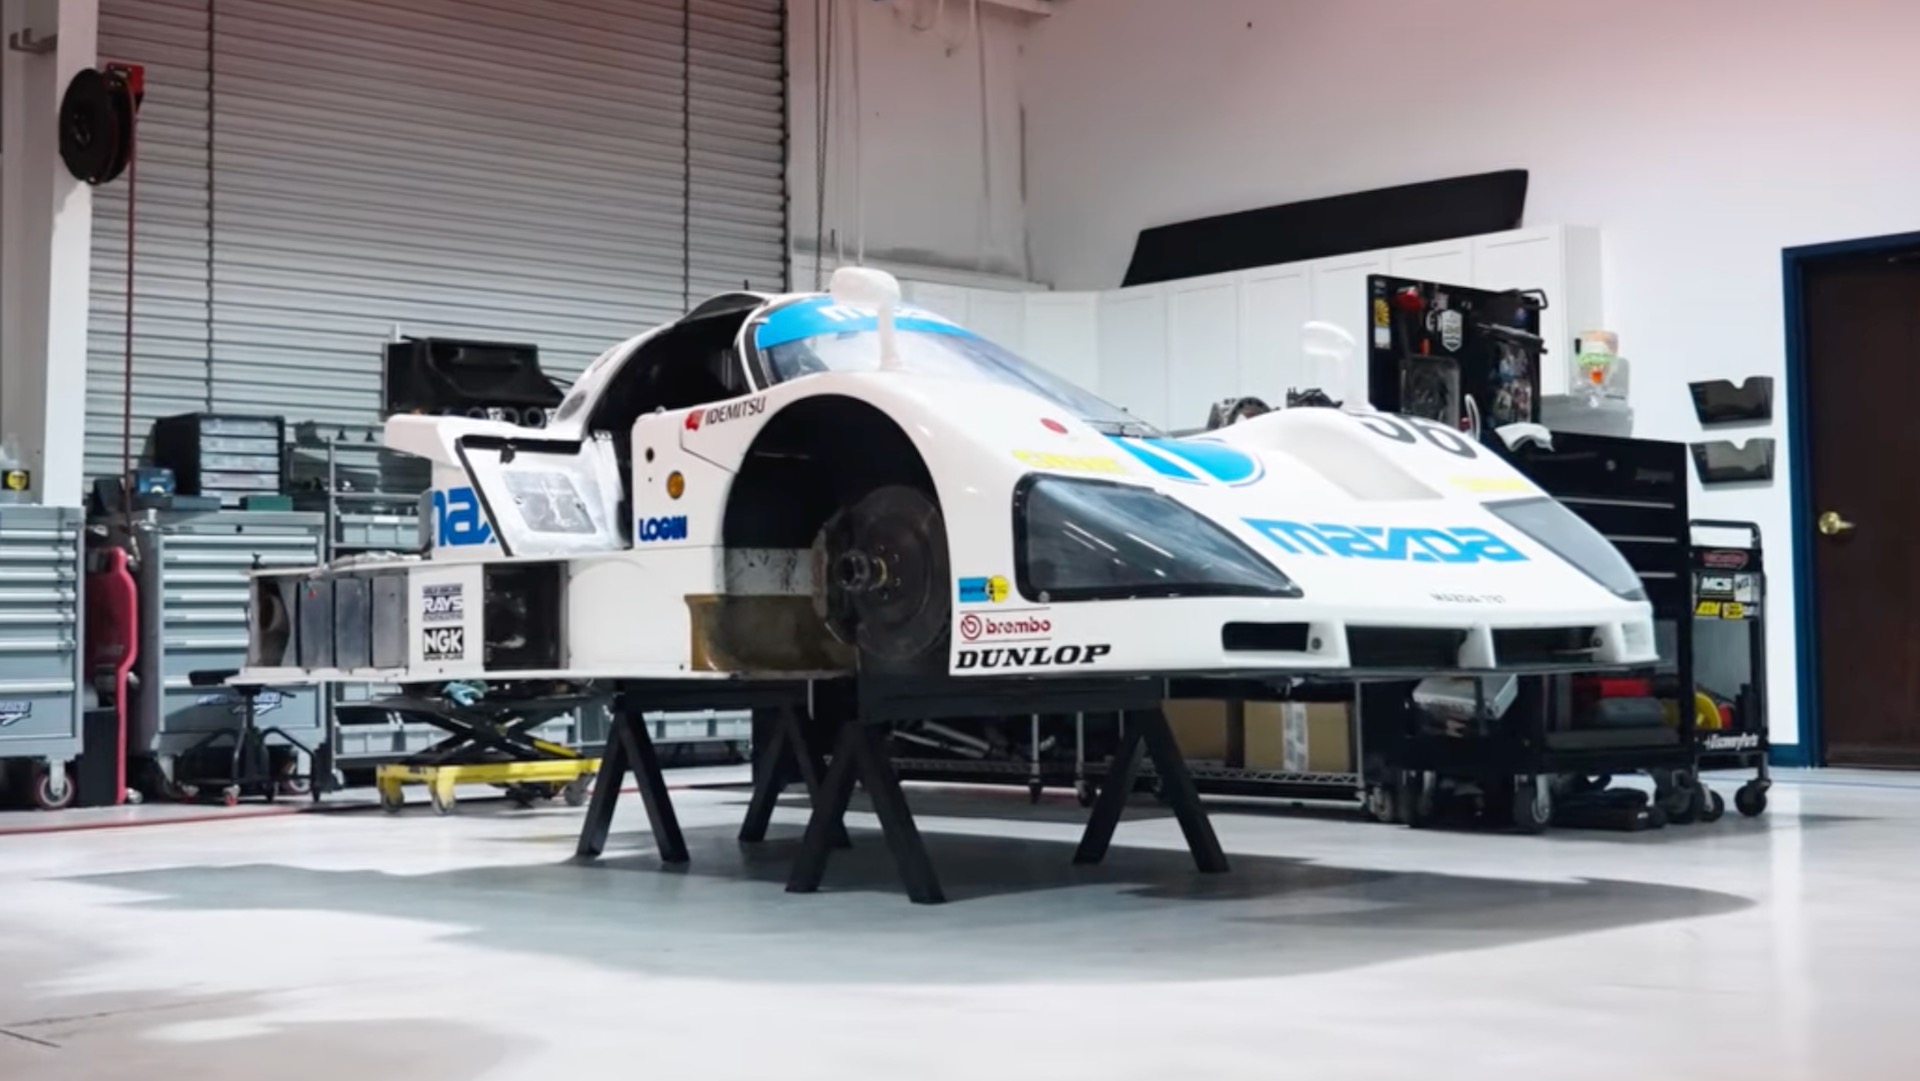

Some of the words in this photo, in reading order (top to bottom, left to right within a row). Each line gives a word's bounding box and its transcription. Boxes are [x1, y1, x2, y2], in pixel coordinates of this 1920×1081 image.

[705, 396, 767, 426] IDEMITSU
[639, 514, 688, 542] LOGIN
[1239, 517, 1532, 563] mazda
[1702, 576, 1732, 591] MCS
[424, 595, 463, 613] RAYS
[986, 616, 1052, 634] brembo
[424, 629, 462, 654] NGK
[955, 644, 1111, 669] DUNLOP
